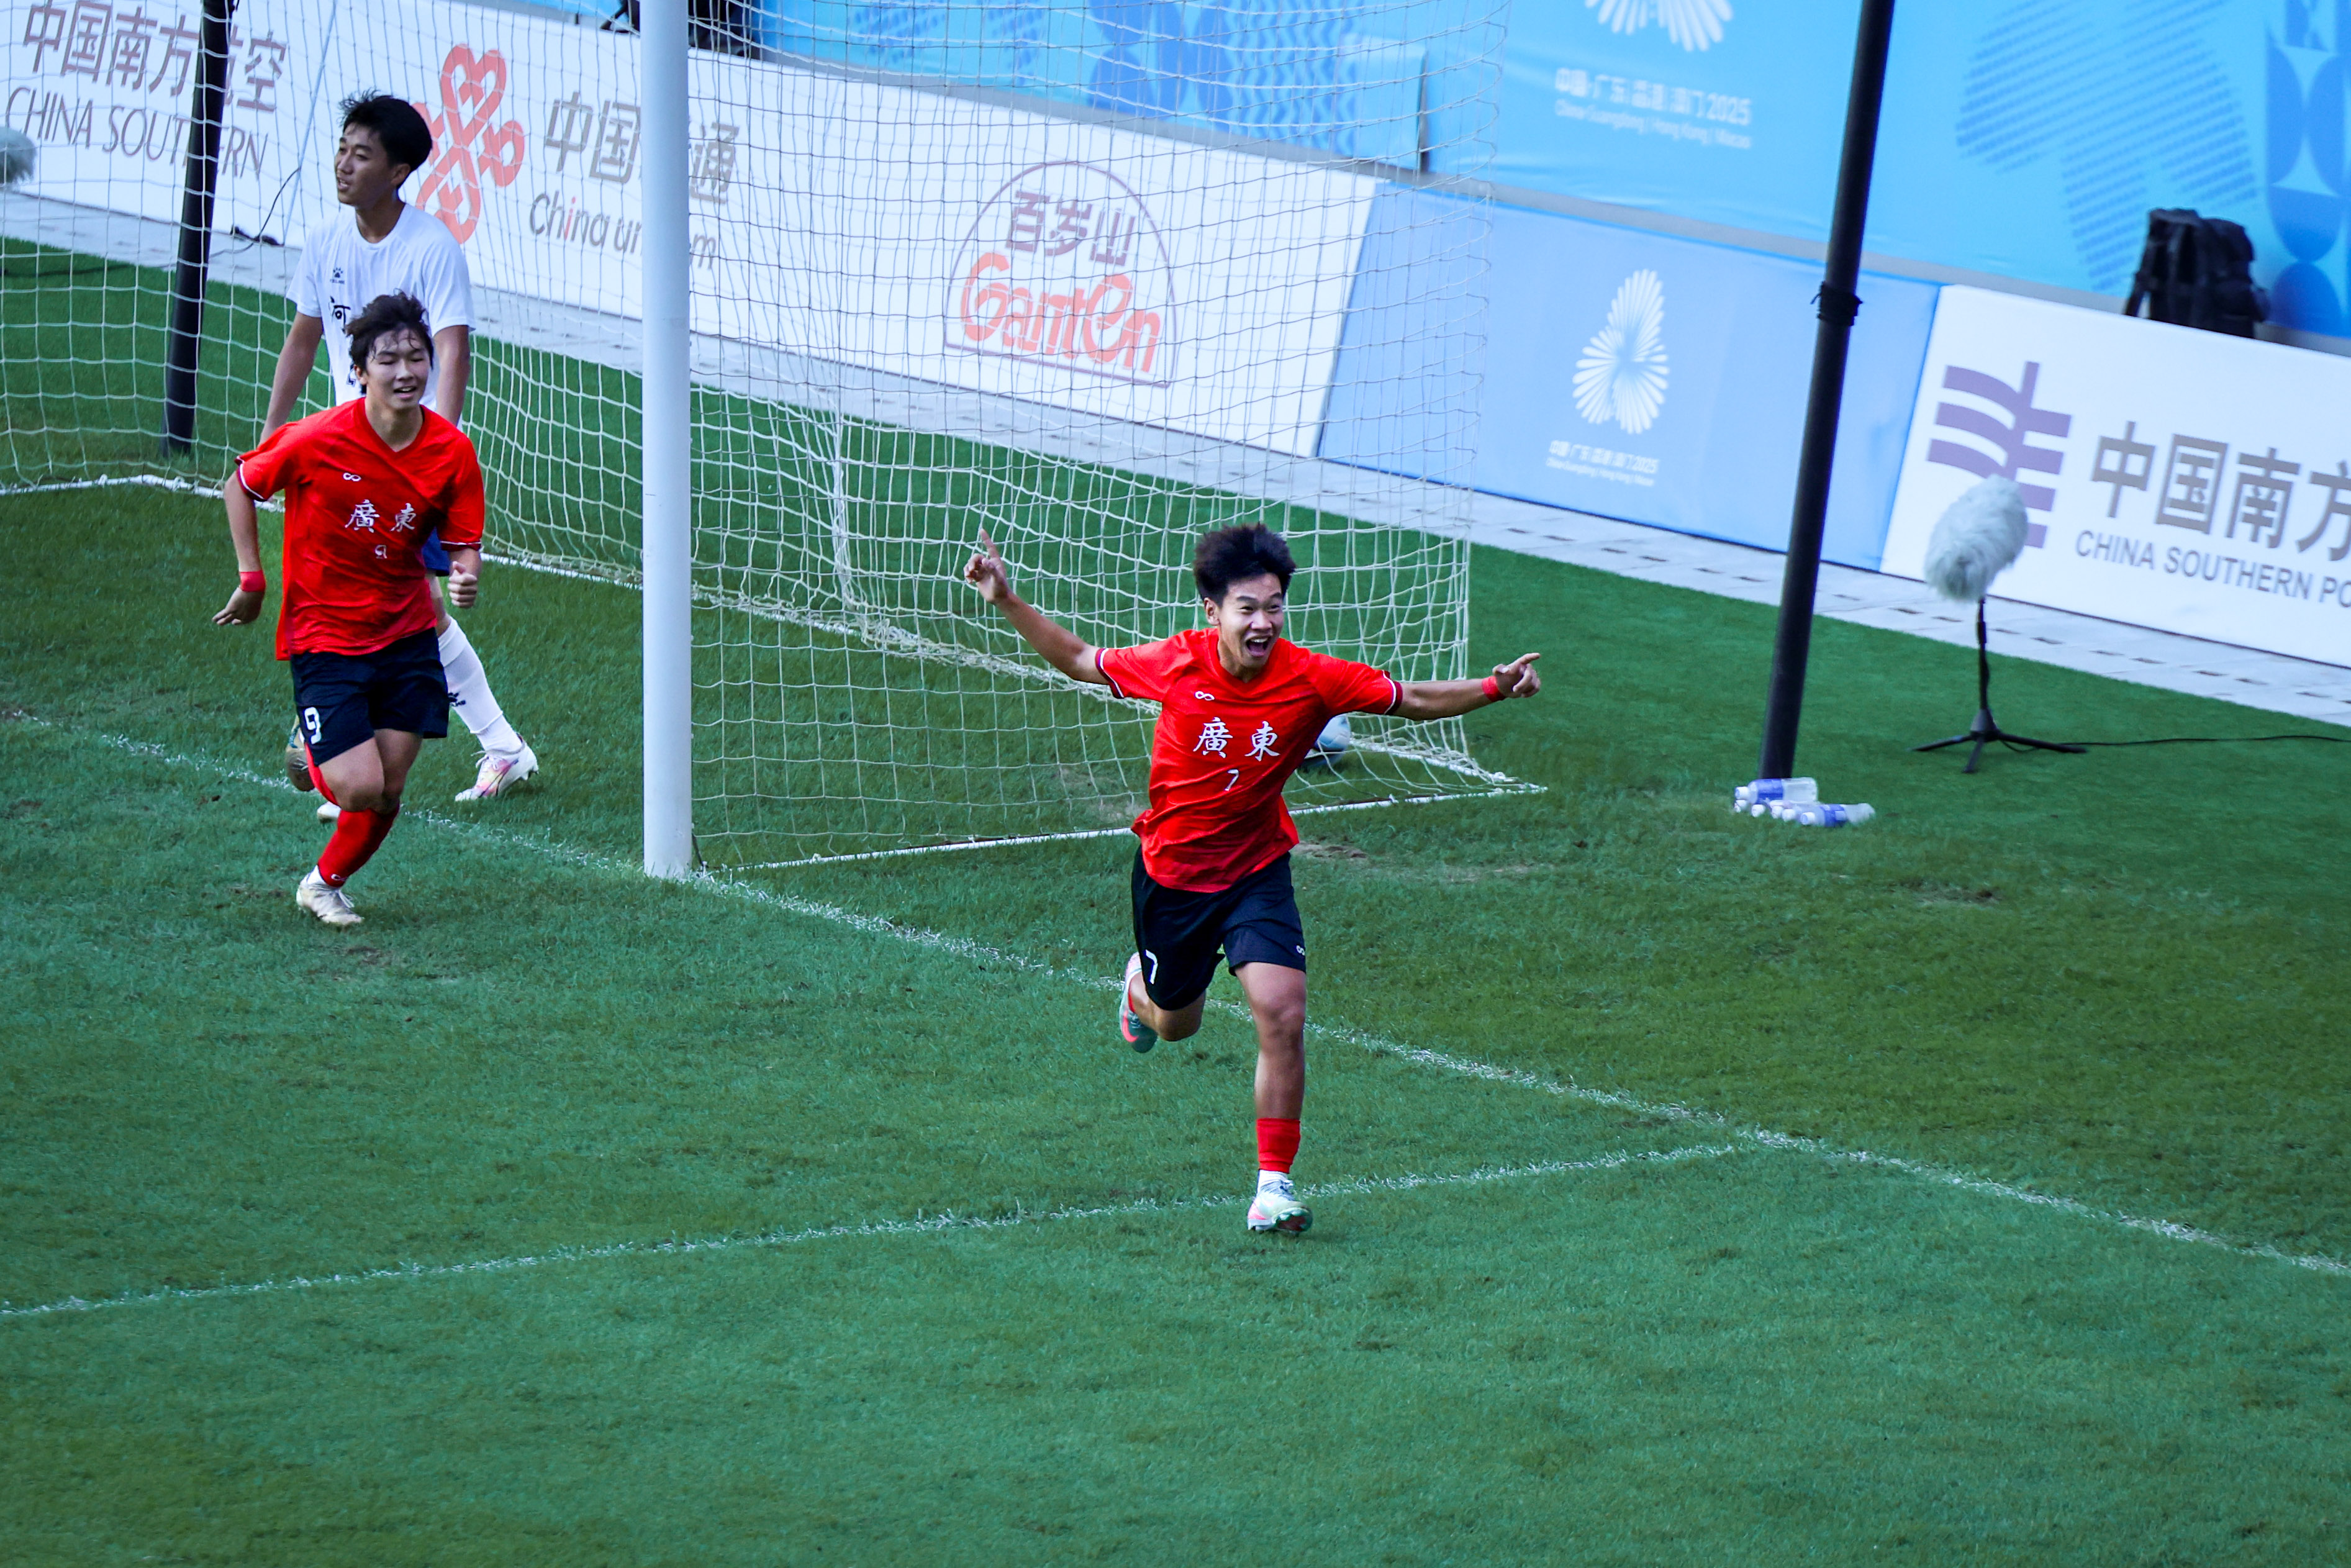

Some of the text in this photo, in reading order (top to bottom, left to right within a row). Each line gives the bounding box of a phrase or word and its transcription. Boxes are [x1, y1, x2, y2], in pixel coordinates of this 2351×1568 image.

[23, 0, 286, 113] 中国南方空
[6, 86, 269, 181] CHINA SOUTRN
[544, 91, 739, 204] 中国通
[530, 190, 610, 246] China
[1006, 190, 1136, 266] 百岁山
[2091, 420, 2351, 561] 中国南方
[2075, 530, 2155, 570] CHINA
[2163, 546, 2313, 600] SOUTHERN
[304, 707, 322, 745] 9
[1225, 769, 1239, 791] 7
[1145, 949, 1158, 985] 7
